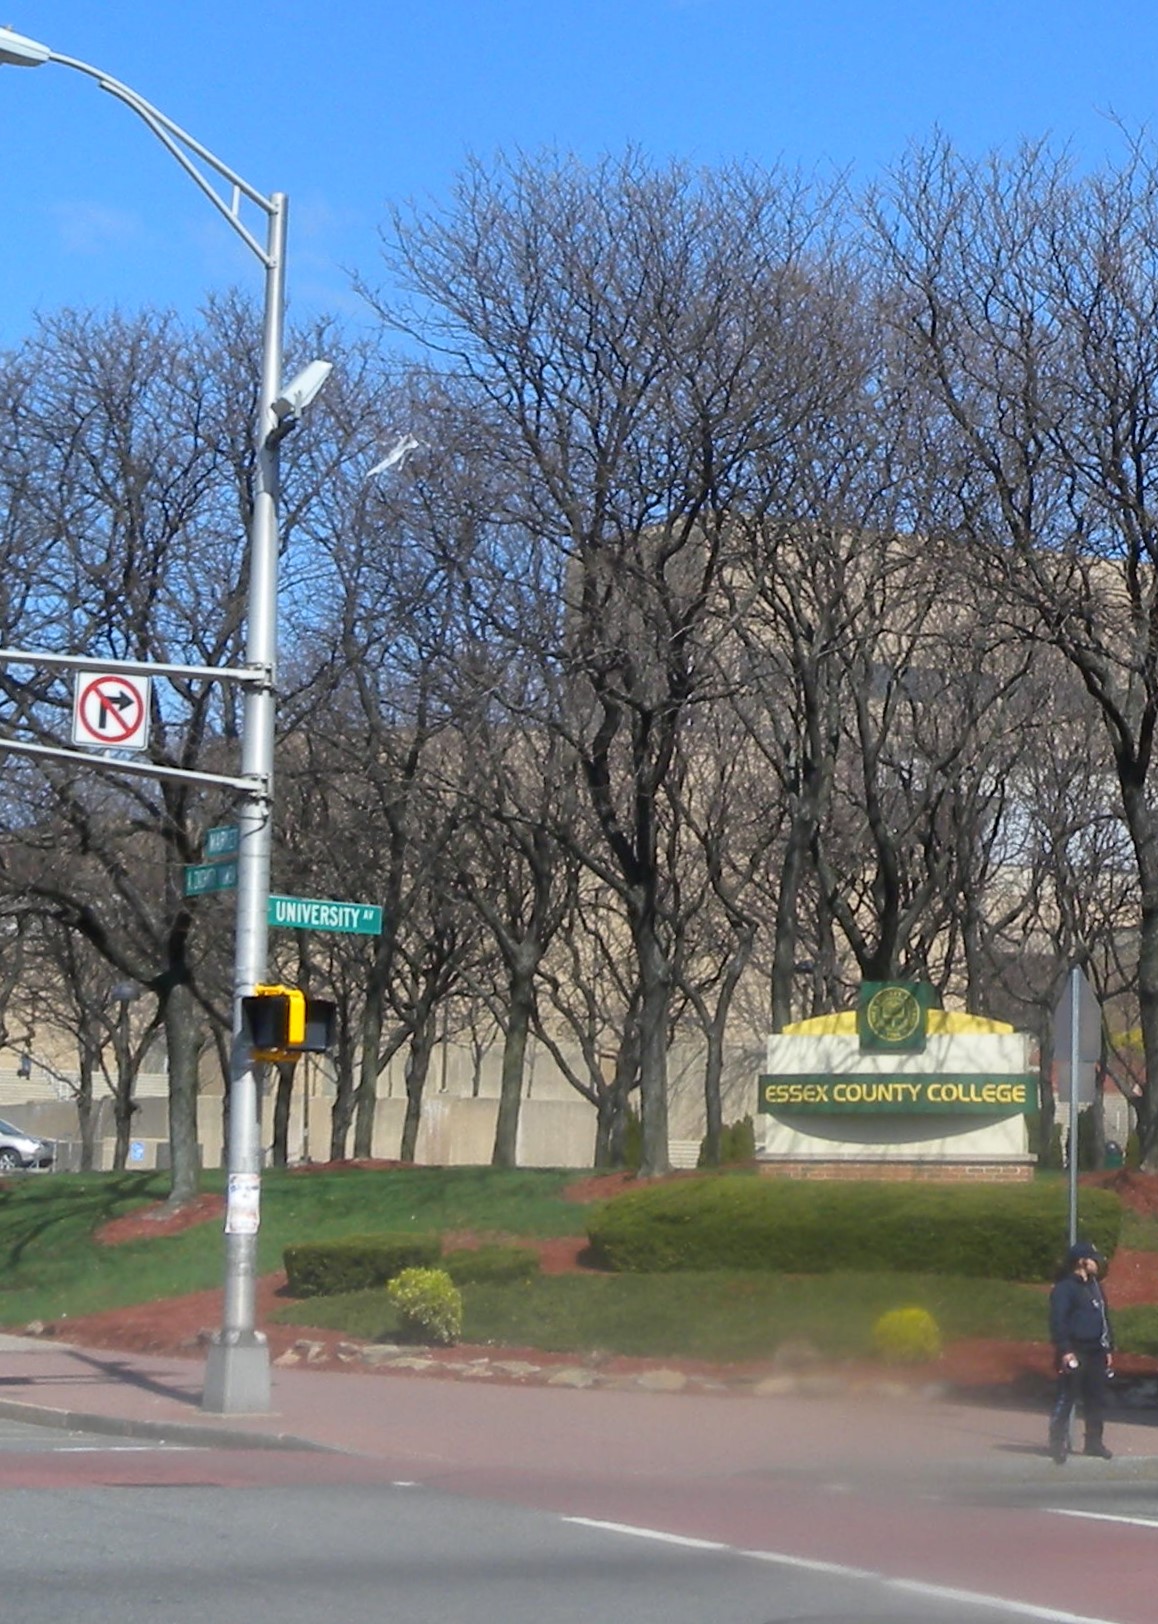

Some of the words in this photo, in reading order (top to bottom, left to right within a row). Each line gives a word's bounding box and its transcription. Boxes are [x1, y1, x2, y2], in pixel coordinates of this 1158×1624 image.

[276, 901, 360, 928] UNIVERSITY
[765, 1084, 829, 1102] ESSEX
[833, 1083, 921, 1102] COUNTY
[927, 1083, 1026, 1103] COLLEGE
